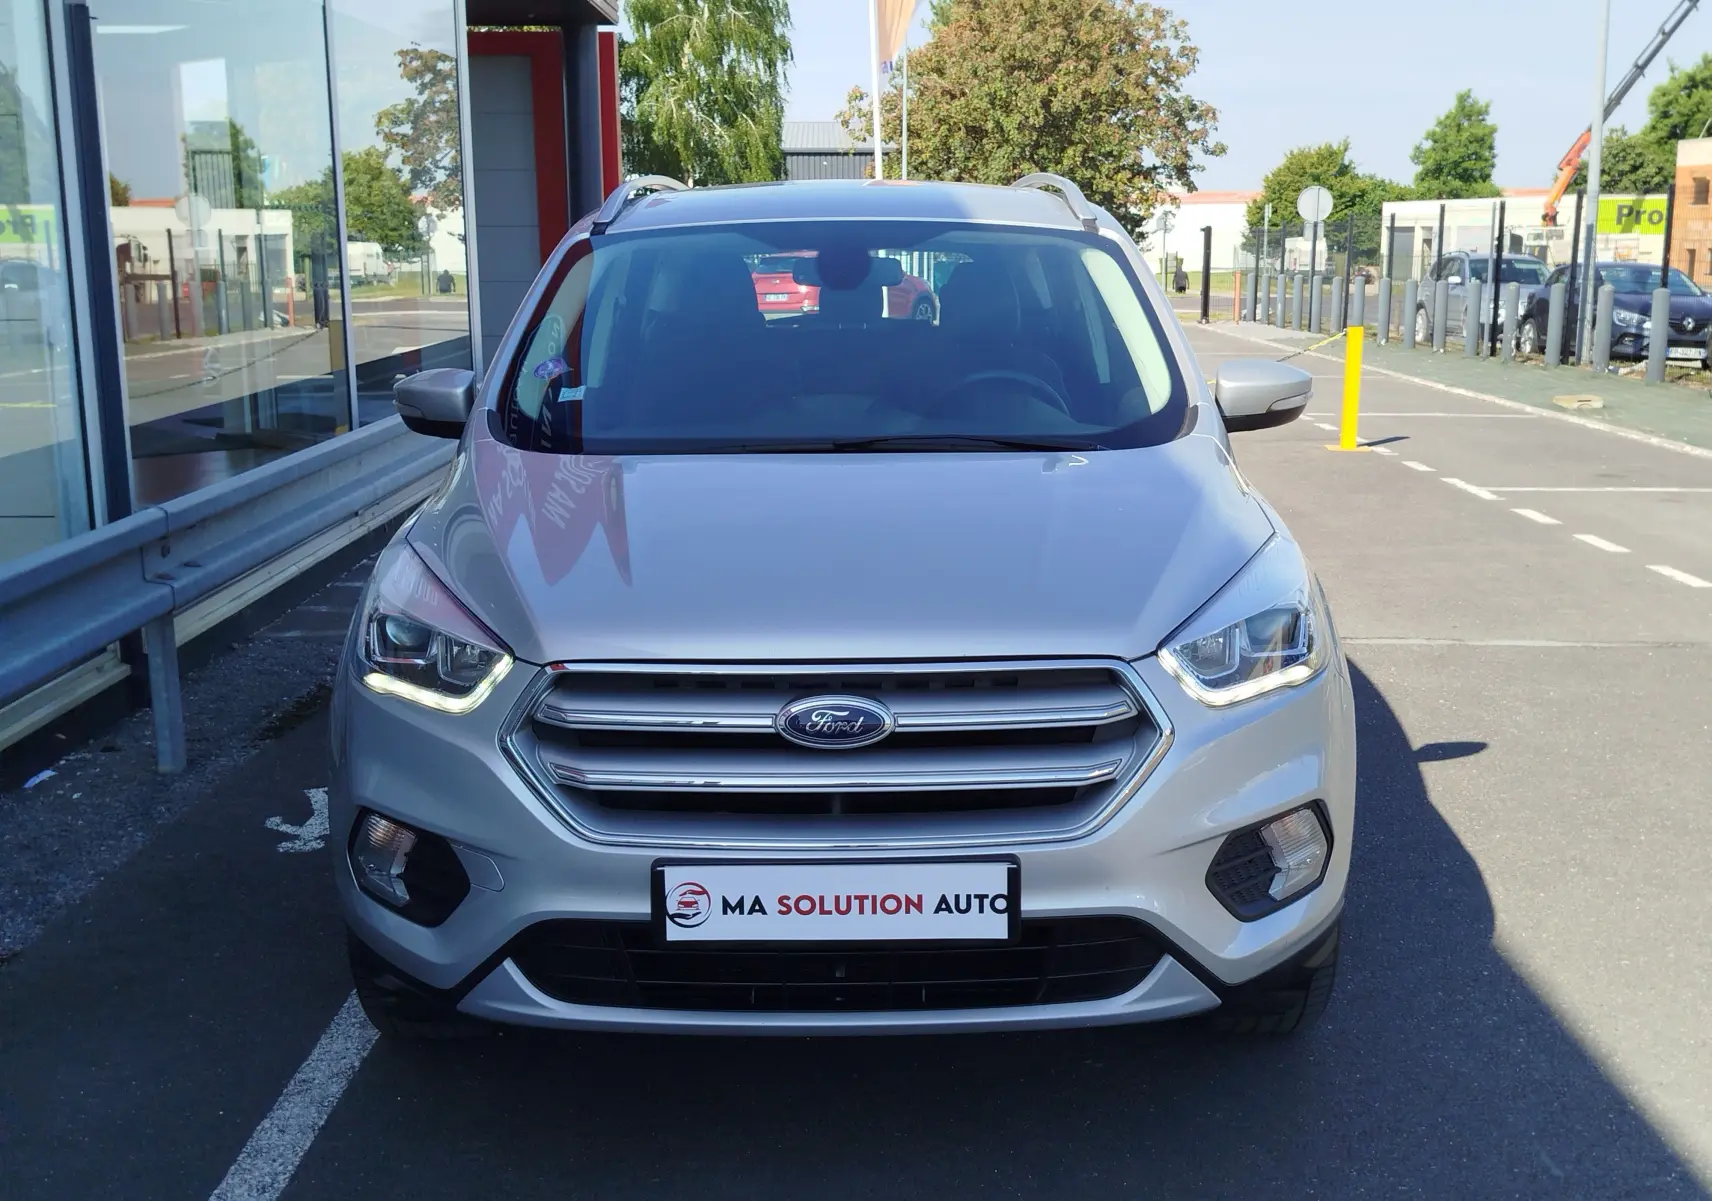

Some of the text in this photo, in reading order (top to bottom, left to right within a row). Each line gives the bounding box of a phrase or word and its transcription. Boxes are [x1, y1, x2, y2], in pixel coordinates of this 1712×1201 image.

[1616, 204, 1664, 225] Pro
[805, 709, 865, 735] Ford
[721, 893, 1009, 916] MA SOLUTION AUTO
